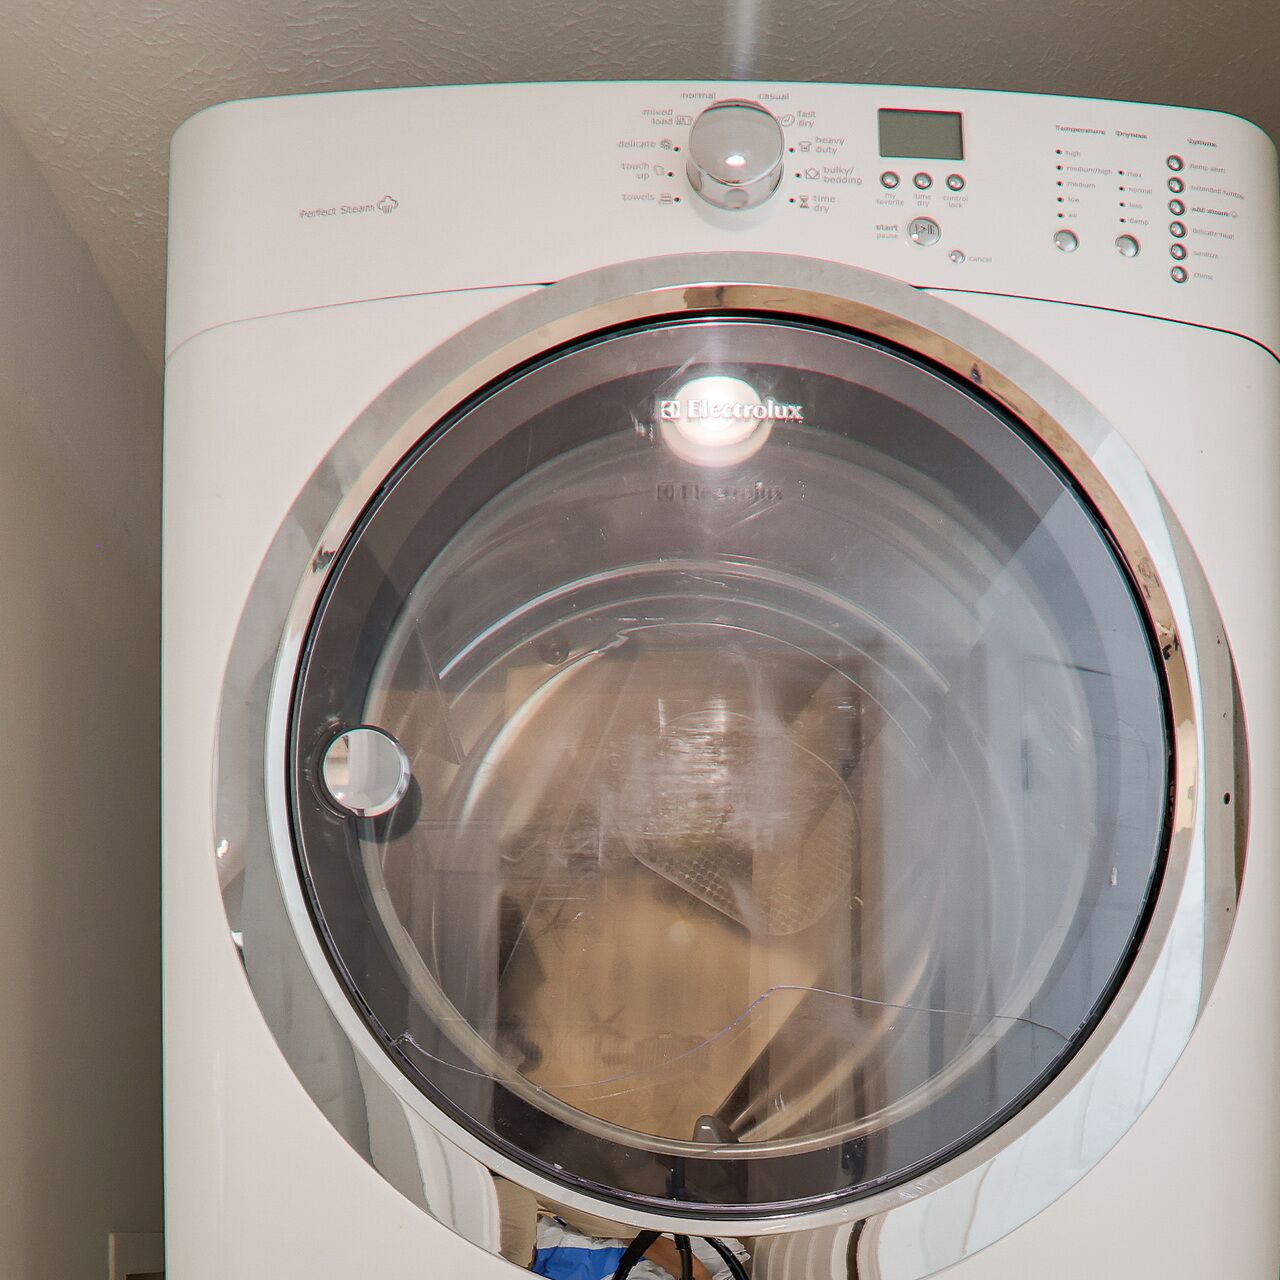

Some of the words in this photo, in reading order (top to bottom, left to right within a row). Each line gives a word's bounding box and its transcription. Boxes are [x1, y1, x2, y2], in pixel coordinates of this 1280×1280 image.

[758, 92, 790, 100] casual
[797, 110, 816, 118] fast
[797, 119, 815, 128] dry
[617, 140, 657, 148] delicate
[815, 136, 845, 146] heavy
[815, 145, 838, 155] duty
[621, 162, 650, 170] touch
[823, 165, 854, 176] bulky/
[636, 172, 650, 180] up
[823, 176, 863, 186] bedding
[621, 193, 655, 201] towels
[813, 194, 836, 203] time
[340, 204, 375, 215] Steam
[813, 204, 830, 214] dry
[686, 398, 805, 421] Electrolux
